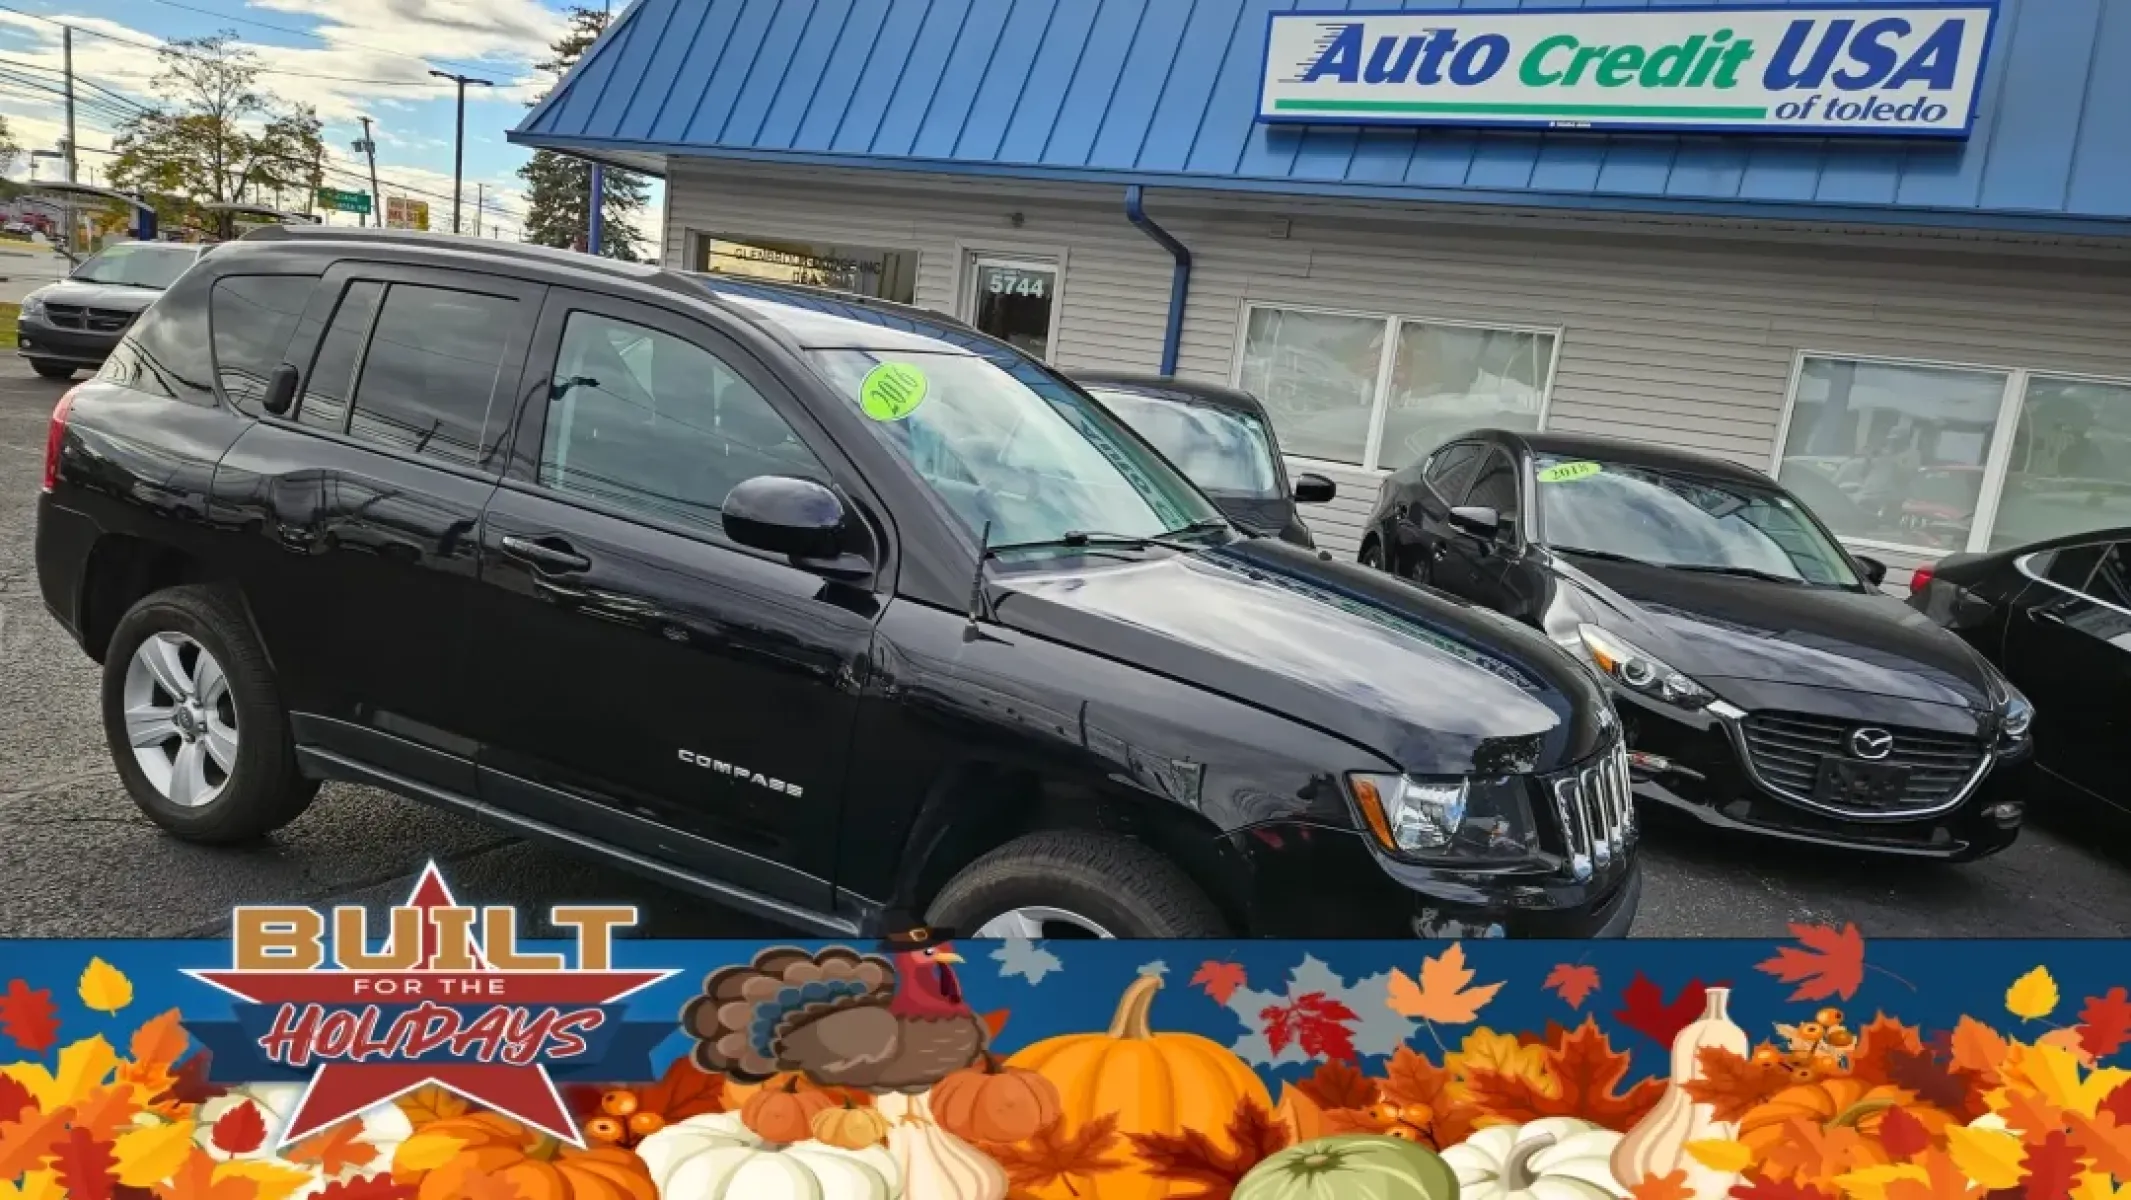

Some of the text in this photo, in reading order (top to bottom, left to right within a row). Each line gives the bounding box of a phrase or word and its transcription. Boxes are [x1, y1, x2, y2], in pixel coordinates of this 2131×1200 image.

[1296, 17, 1966, 92] Auto Credit USA
[1775, 94, 1948, 123] of toledo
[989, 273, 1044, 299] 5744
[870, 366, 918, 416] 2016
[678, 748, 804, 798] COMPASS
